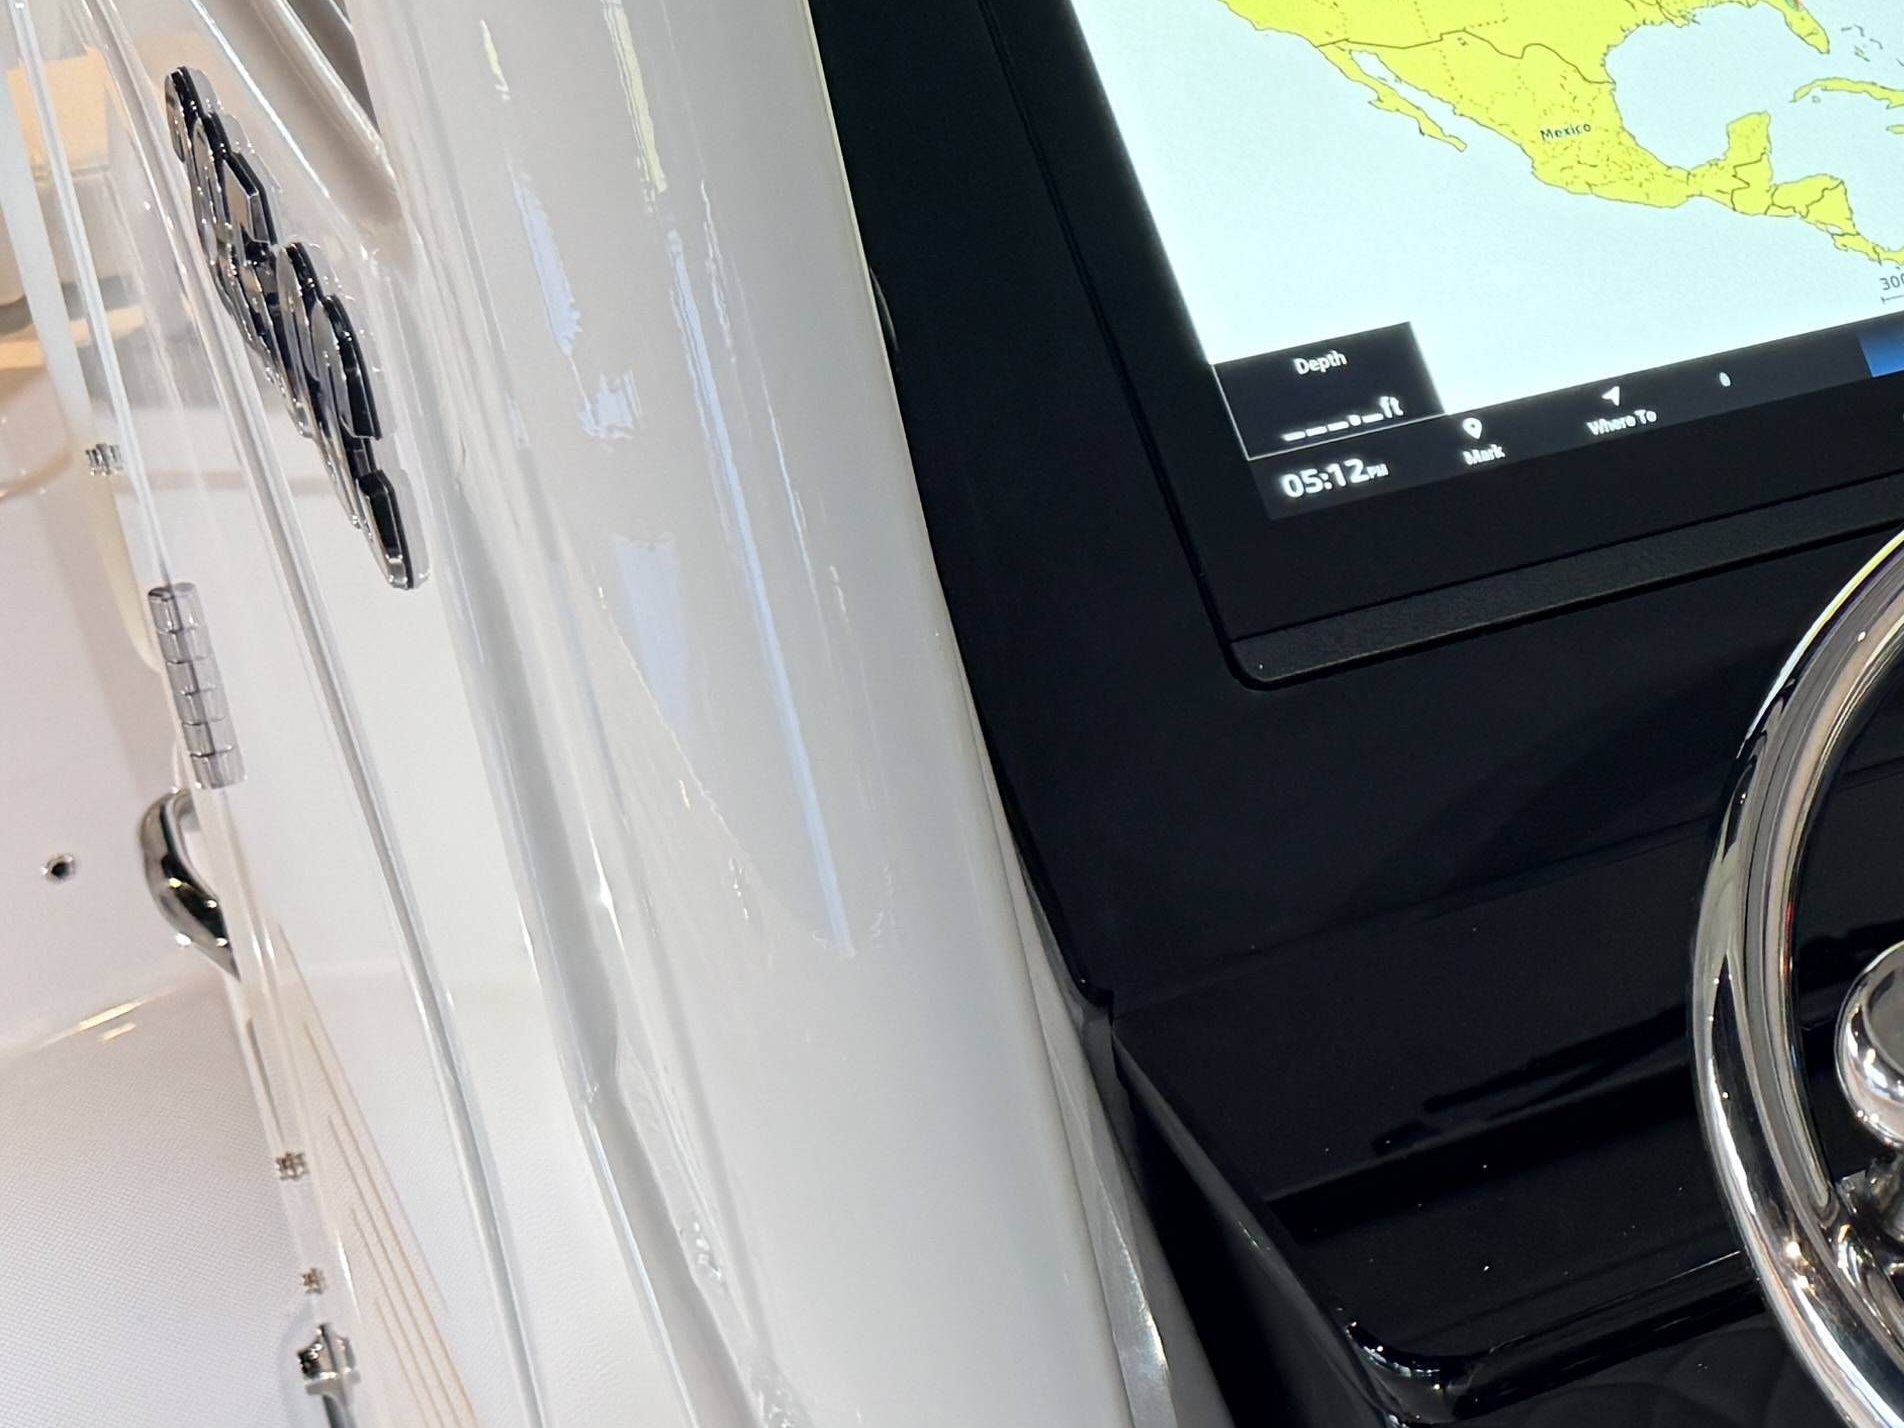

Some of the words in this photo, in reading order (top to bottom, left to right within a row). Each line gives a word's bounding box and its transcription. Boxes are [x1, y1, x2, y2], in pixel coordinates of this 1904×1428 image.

[1540, 123, 1592, 140] Mexico
[1294, 350, 1348, 375] Depth
[1586, 416, 1635, 437] Where
[1634, 408, 1658, 426] To
[1462, 443, 1505, 466] Mark
